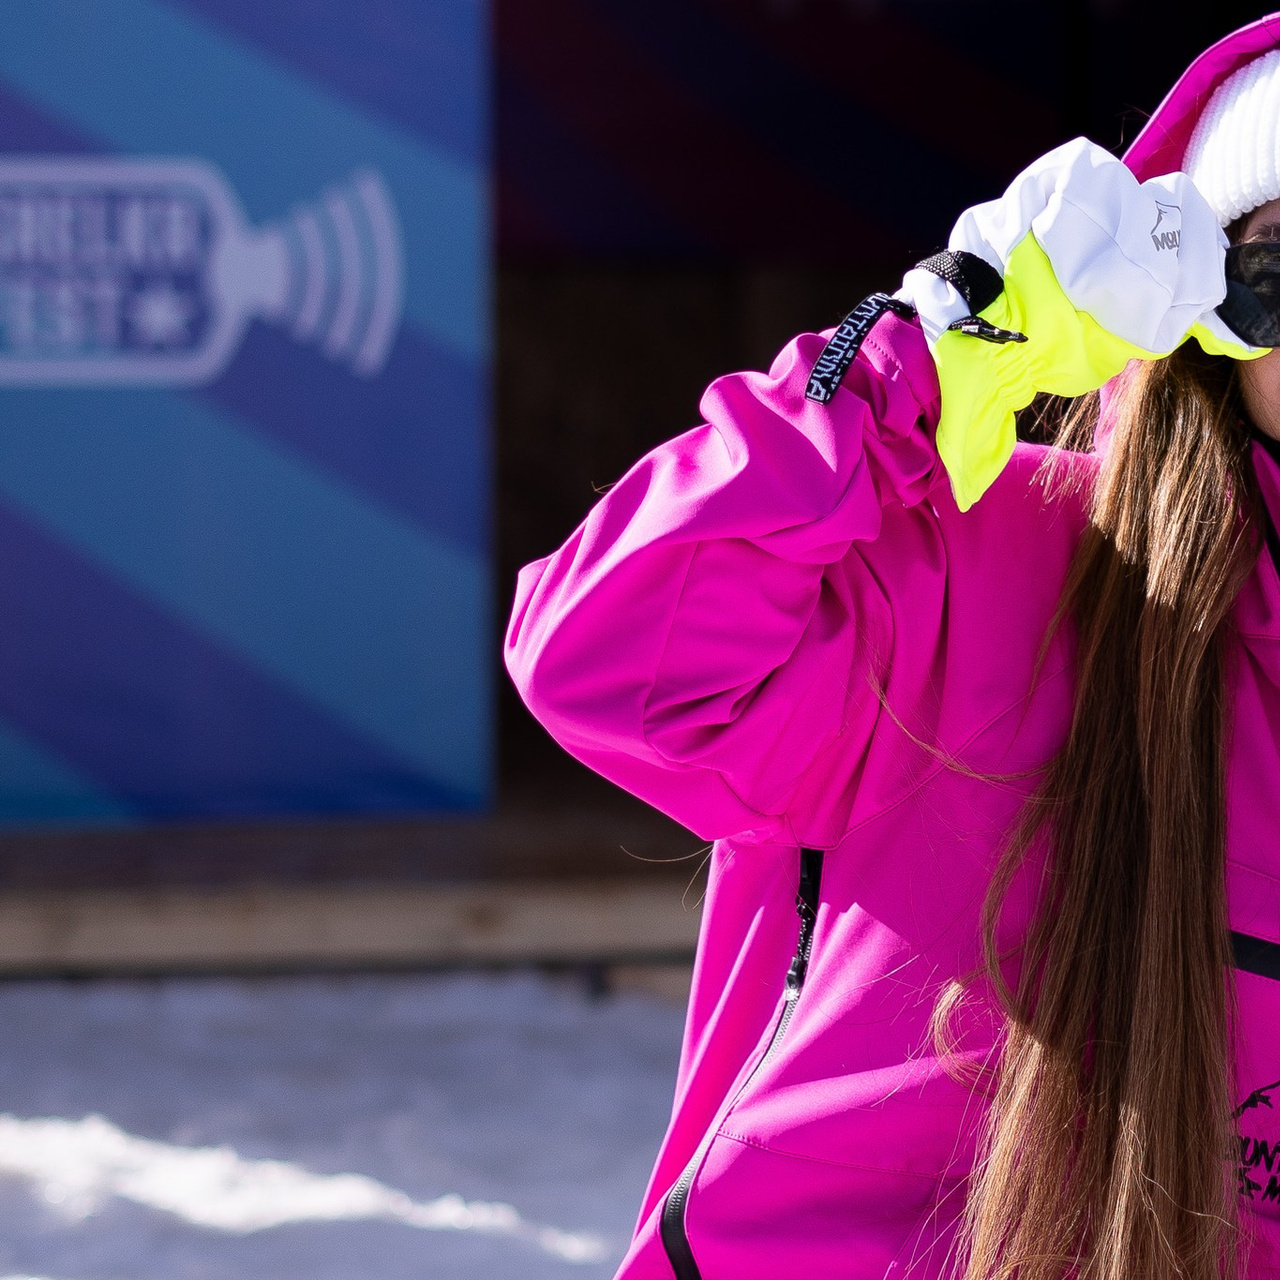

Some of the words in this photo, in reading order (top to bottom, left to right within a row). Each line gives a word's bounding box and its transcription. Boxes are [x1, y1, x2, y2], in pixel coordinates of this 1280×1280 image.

[0, 198, 203, 267] RELKA
[1151, 230, 1181, 252] MOU
[6, 273, 120, 347] EST
